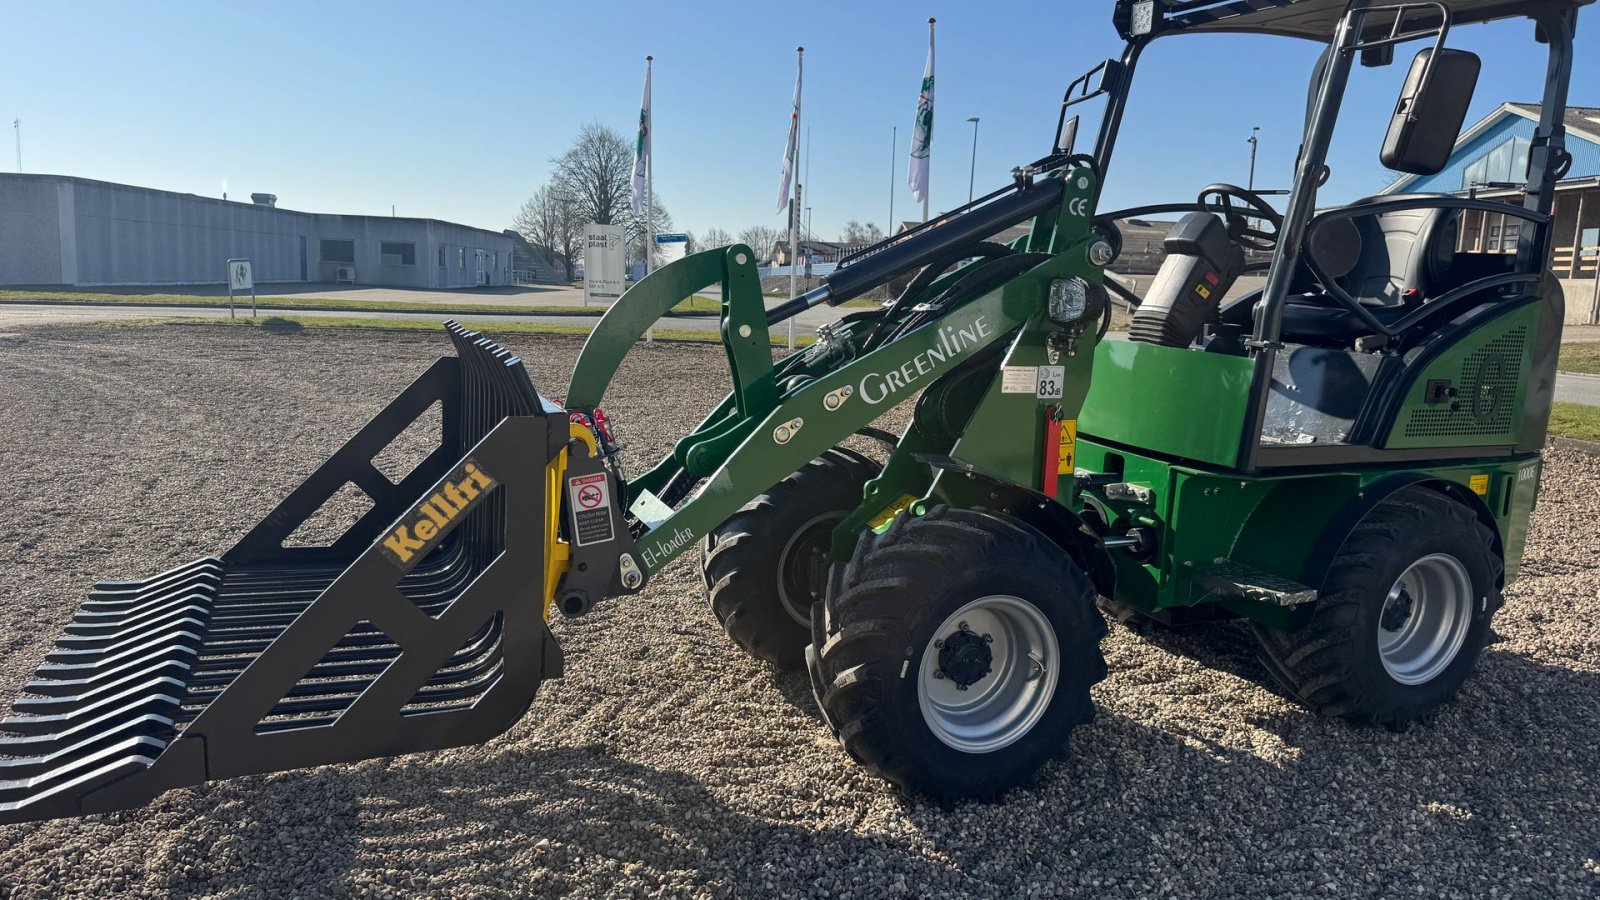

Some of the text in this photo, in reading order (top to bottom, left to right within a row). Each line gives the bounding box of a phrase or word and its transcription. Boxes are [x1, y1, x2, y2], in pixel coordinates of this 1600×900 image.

[1069, 197, 1088, 217] CE
[1040, 380, 1055, 395] 83
[383, 463, 491, 562] Kellfri
